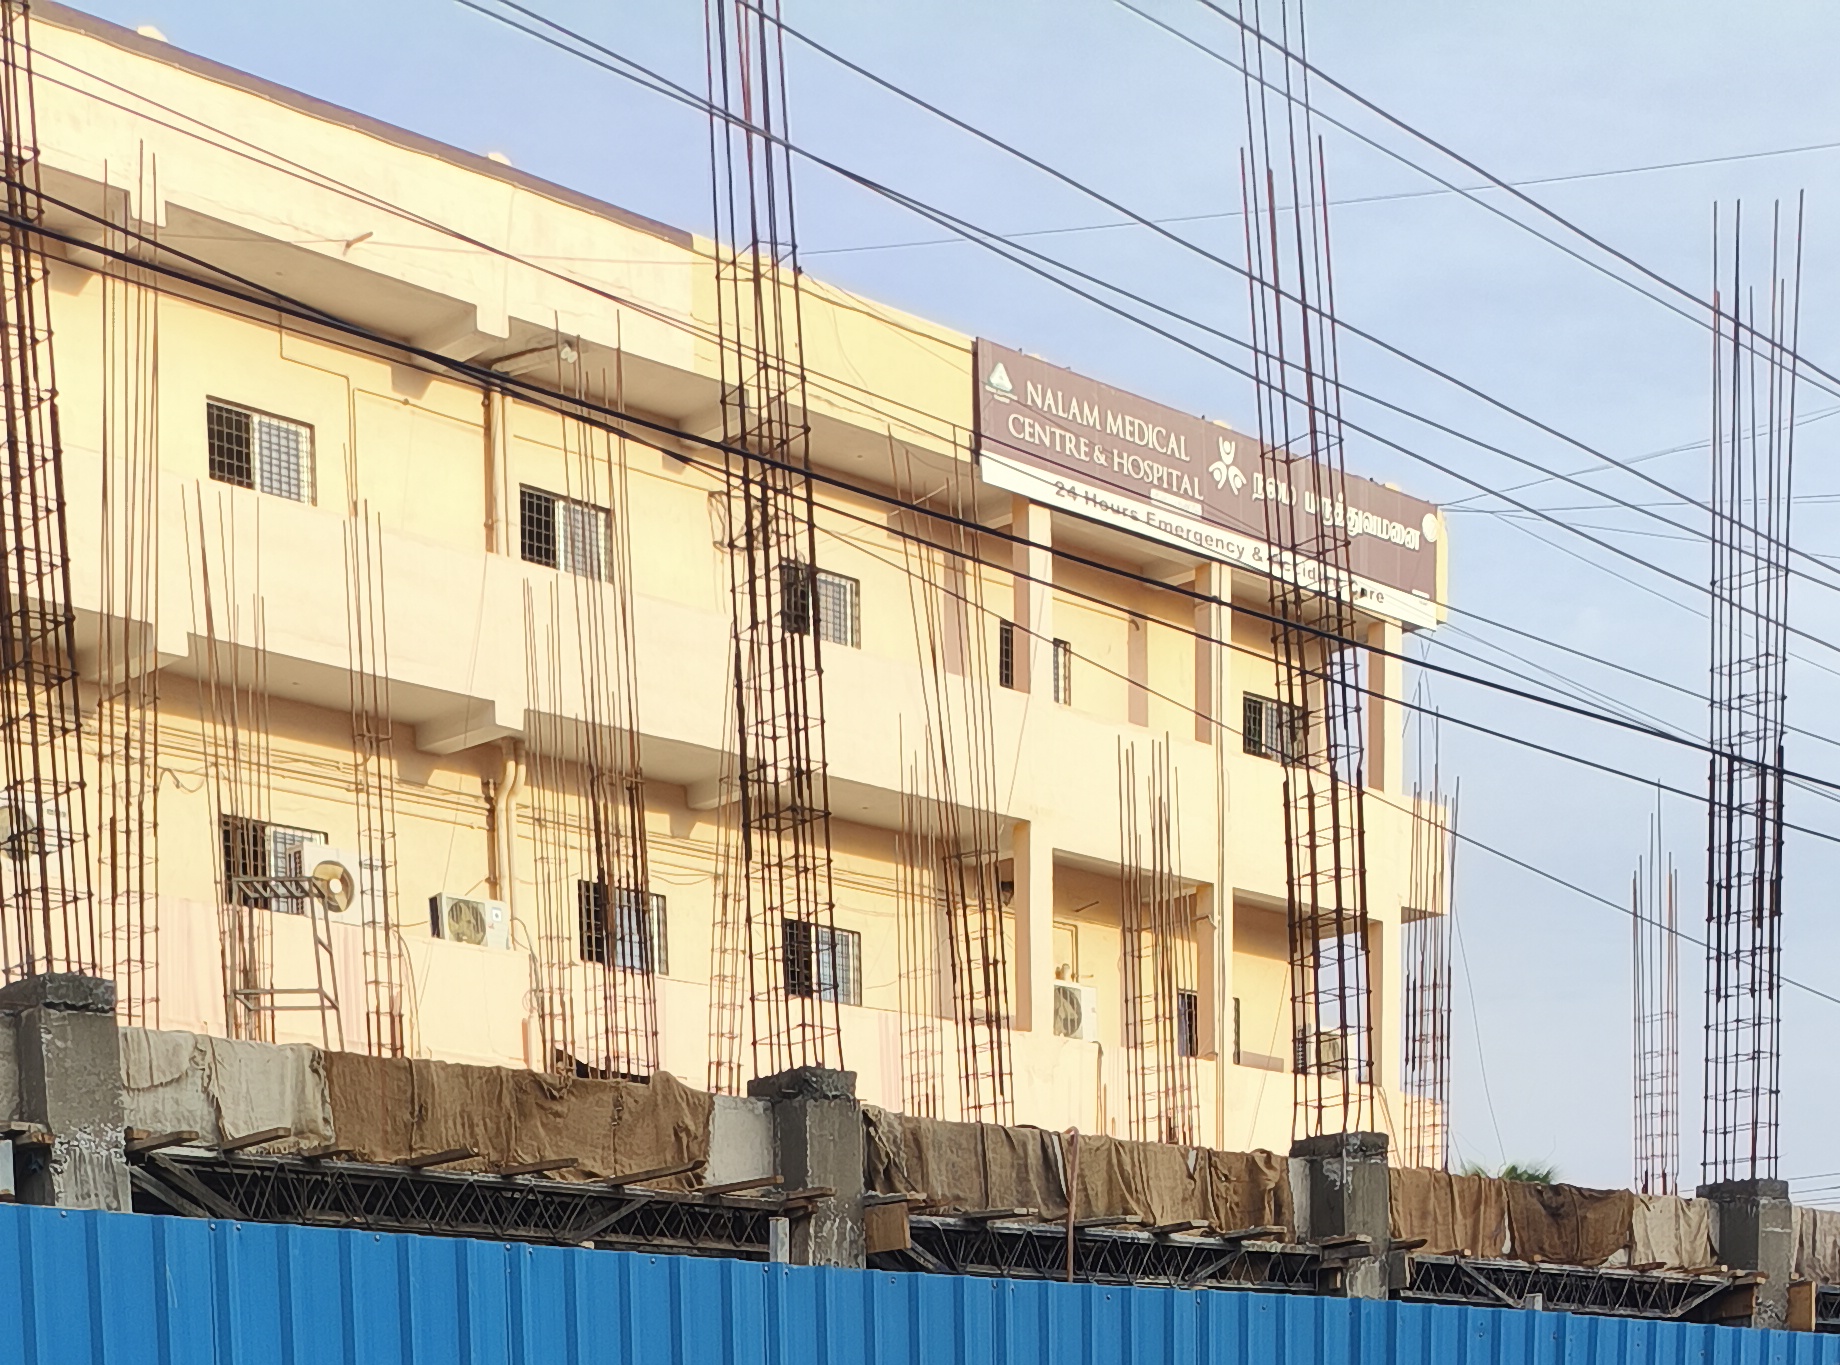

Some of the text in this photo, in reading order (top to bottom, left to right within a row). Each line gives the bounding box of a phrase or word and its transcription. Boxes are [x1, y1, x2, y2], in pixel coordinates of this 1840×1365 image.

[1008, 413, 1204, 501] CENTRE & HOSPITAL
[1026, 380, 1191, 462] NALAM MEDICAL
[1084, 489, 1140, 521] Hours
[1146, 511, 1245, 560] Emergency
[1252, 546, 1263, 562] &
